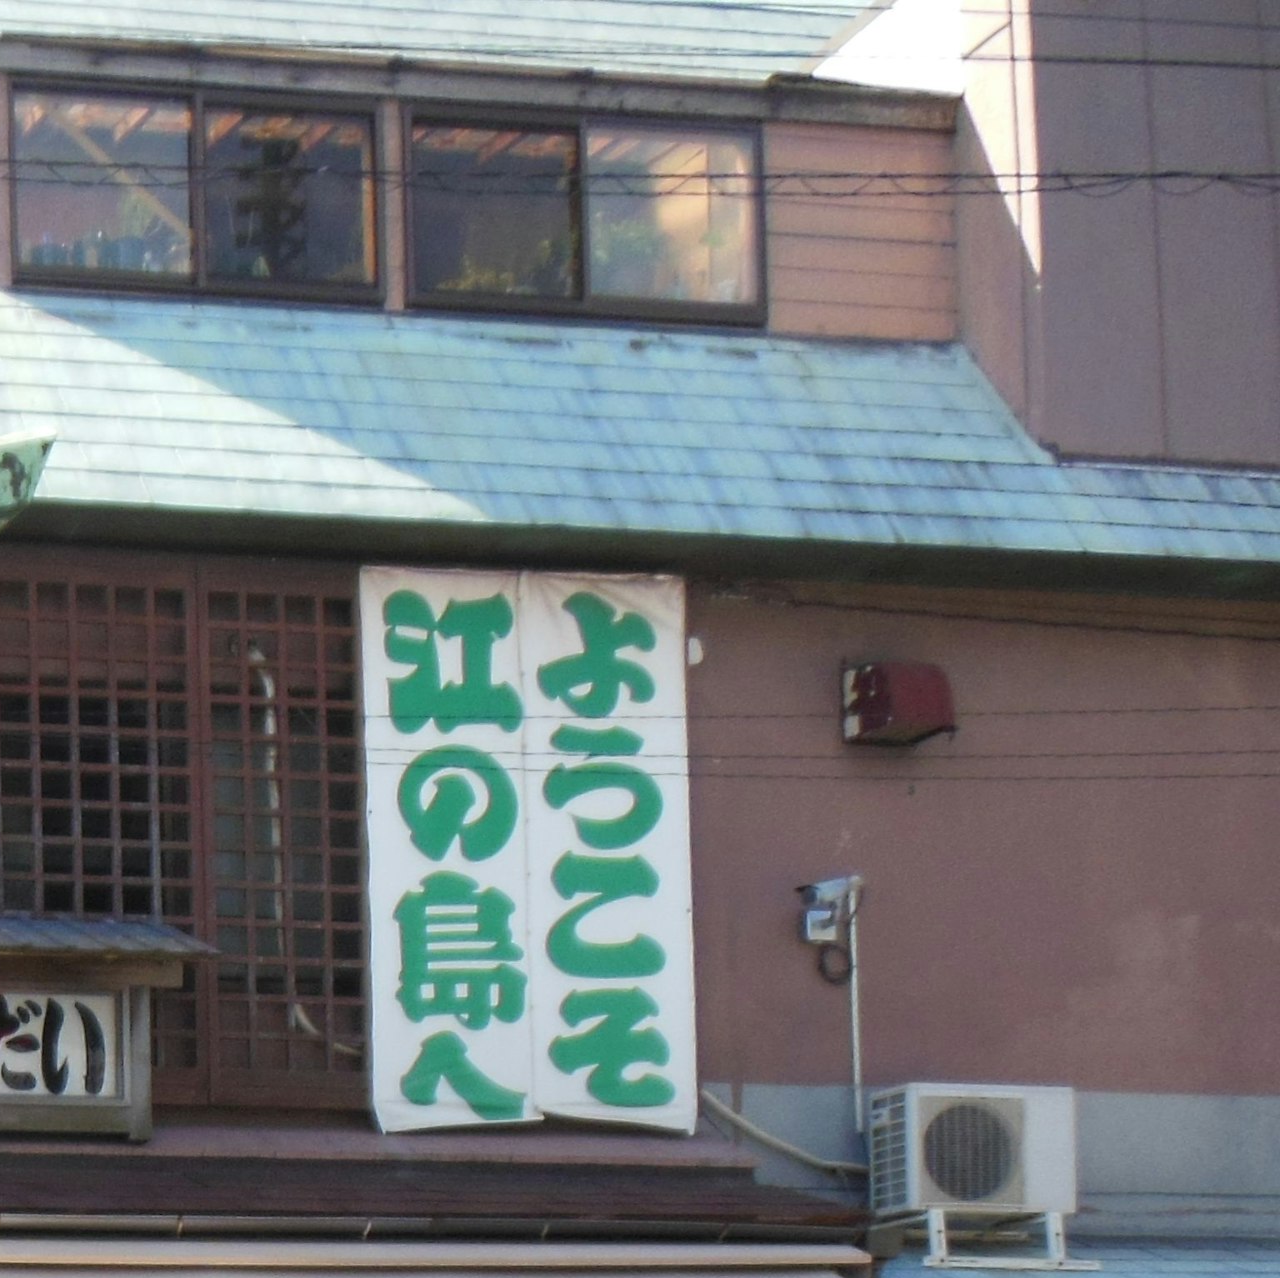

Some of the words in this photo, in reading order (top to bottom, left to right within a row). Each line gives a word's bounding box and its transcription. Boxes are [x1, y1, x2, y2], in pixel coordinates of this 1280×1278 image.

[382, 589, 529, 1120] 江の島へ
[536, 591, 676, 1108] ようこそ
